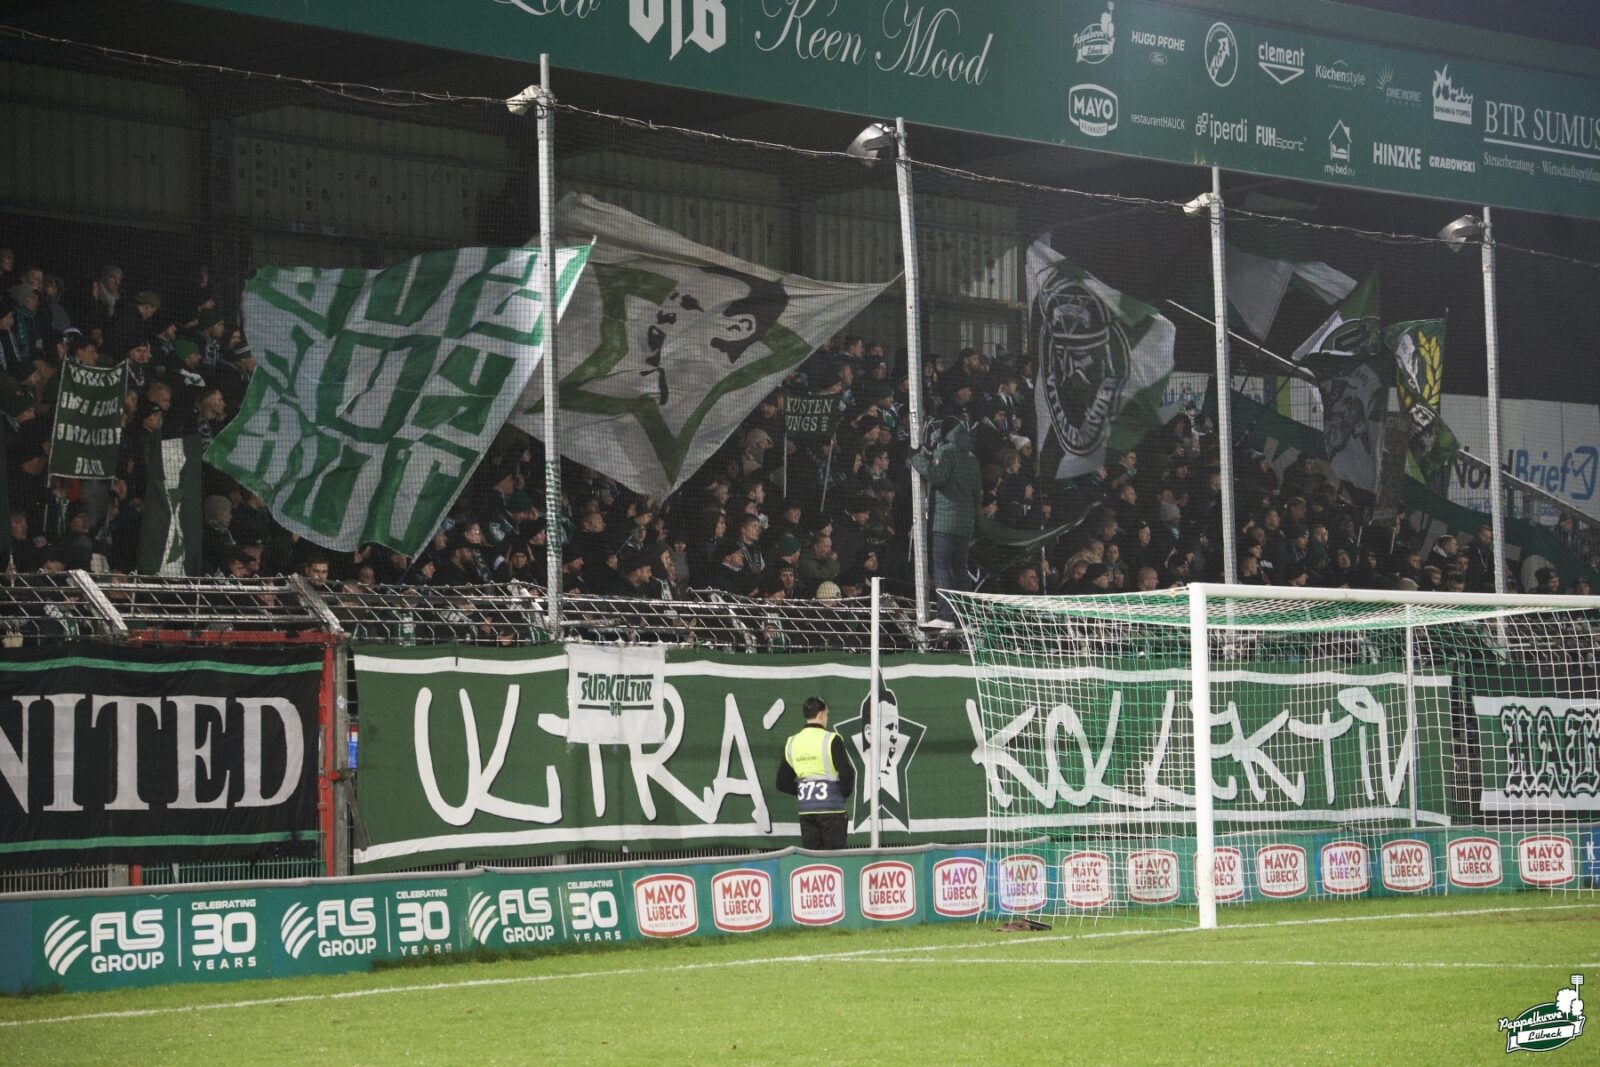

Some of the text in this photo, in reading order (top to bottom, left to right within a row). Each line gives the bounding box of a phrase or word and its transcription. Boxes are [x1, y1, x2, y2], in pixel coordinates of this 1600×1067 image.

[755, 0, 994, 86] Keen Mood
[1131, 31, 1185, 51] HUGO PFOHE
[1258, 43, 1305, 67] clement
[1315, 64, 1366, 87] Küchenstyle
[1074, 94, 1114, 119] MAYO
[1484, 100, 1528, 139] BTR
[1210, 114, 1248, 144] iperdi
[1373, 141, 1422, 170] HINZKE
[1429, 155, 1476, 174] GRABOWSKI
[1483, 152, 1535, 175] Steuerberatung
[581, 673, 652, 702] SUBKULTUR
[797, 781, 829, 800] 373
[1329, 850, 1361, 865] MAYO
[1389, 849, 1423, 864] MAYO
[1456, 845, 1492, 861] MAYO
[1527, 844, 1565, 859] MAYO
[1214, 856, 1235, 871] AYO
[1264, 853, 1299, 869] MAYO
[1390, 863, 1424, 877] LÜBECK
[1458, 861, 1493, 875] LÜBECK
[1528, 859, 1566, 872] LÜBECK
[868, 871, 906, 889] MAYO
[941, 866, 978, 885] MAYO
[1214, 874, 1235, 886] BECK
[1265, 869, 1299, 883] LÜBECK
[1330, 866, 1361, 880] LÜBECK
[567, 880, 613, 890] CELEBRATING
[722, 879, 762, 899] MAYO
[800, 874, 835, 893] MAYO
[396, 889, 448, 900] CELEBRATING
[644, 884, 686, 904] MAYO
[801, 893, 836, 909] LÜBECK
[869, 890, 906, 905] LÜBECK
[942, 886, 978, 900] LÜBECK
[191, 898, 256, 911] CELEBRATING
[499, 888, 553, 926] FLS
[568, 891, 618, 930] 30
[646, 904, 687, 922] LÜBECK
[723, 899, 762, 915] LÜBECK
[317, 898, 376, 938] FLS
[397, 901, 450, 942] 30
[91, 909, 164, 953] FLS
[192, 911, 256, 956] 30
[502, 925, 554, 943] GROUP
[573, 931, 621, 943] YEARS
[317, 938, 376, 957] GROUP
[400, 944, 452, 957] YEARS
[91, 952, 164, 973] GROUP
[193, 956, 257, 971] YEARS
